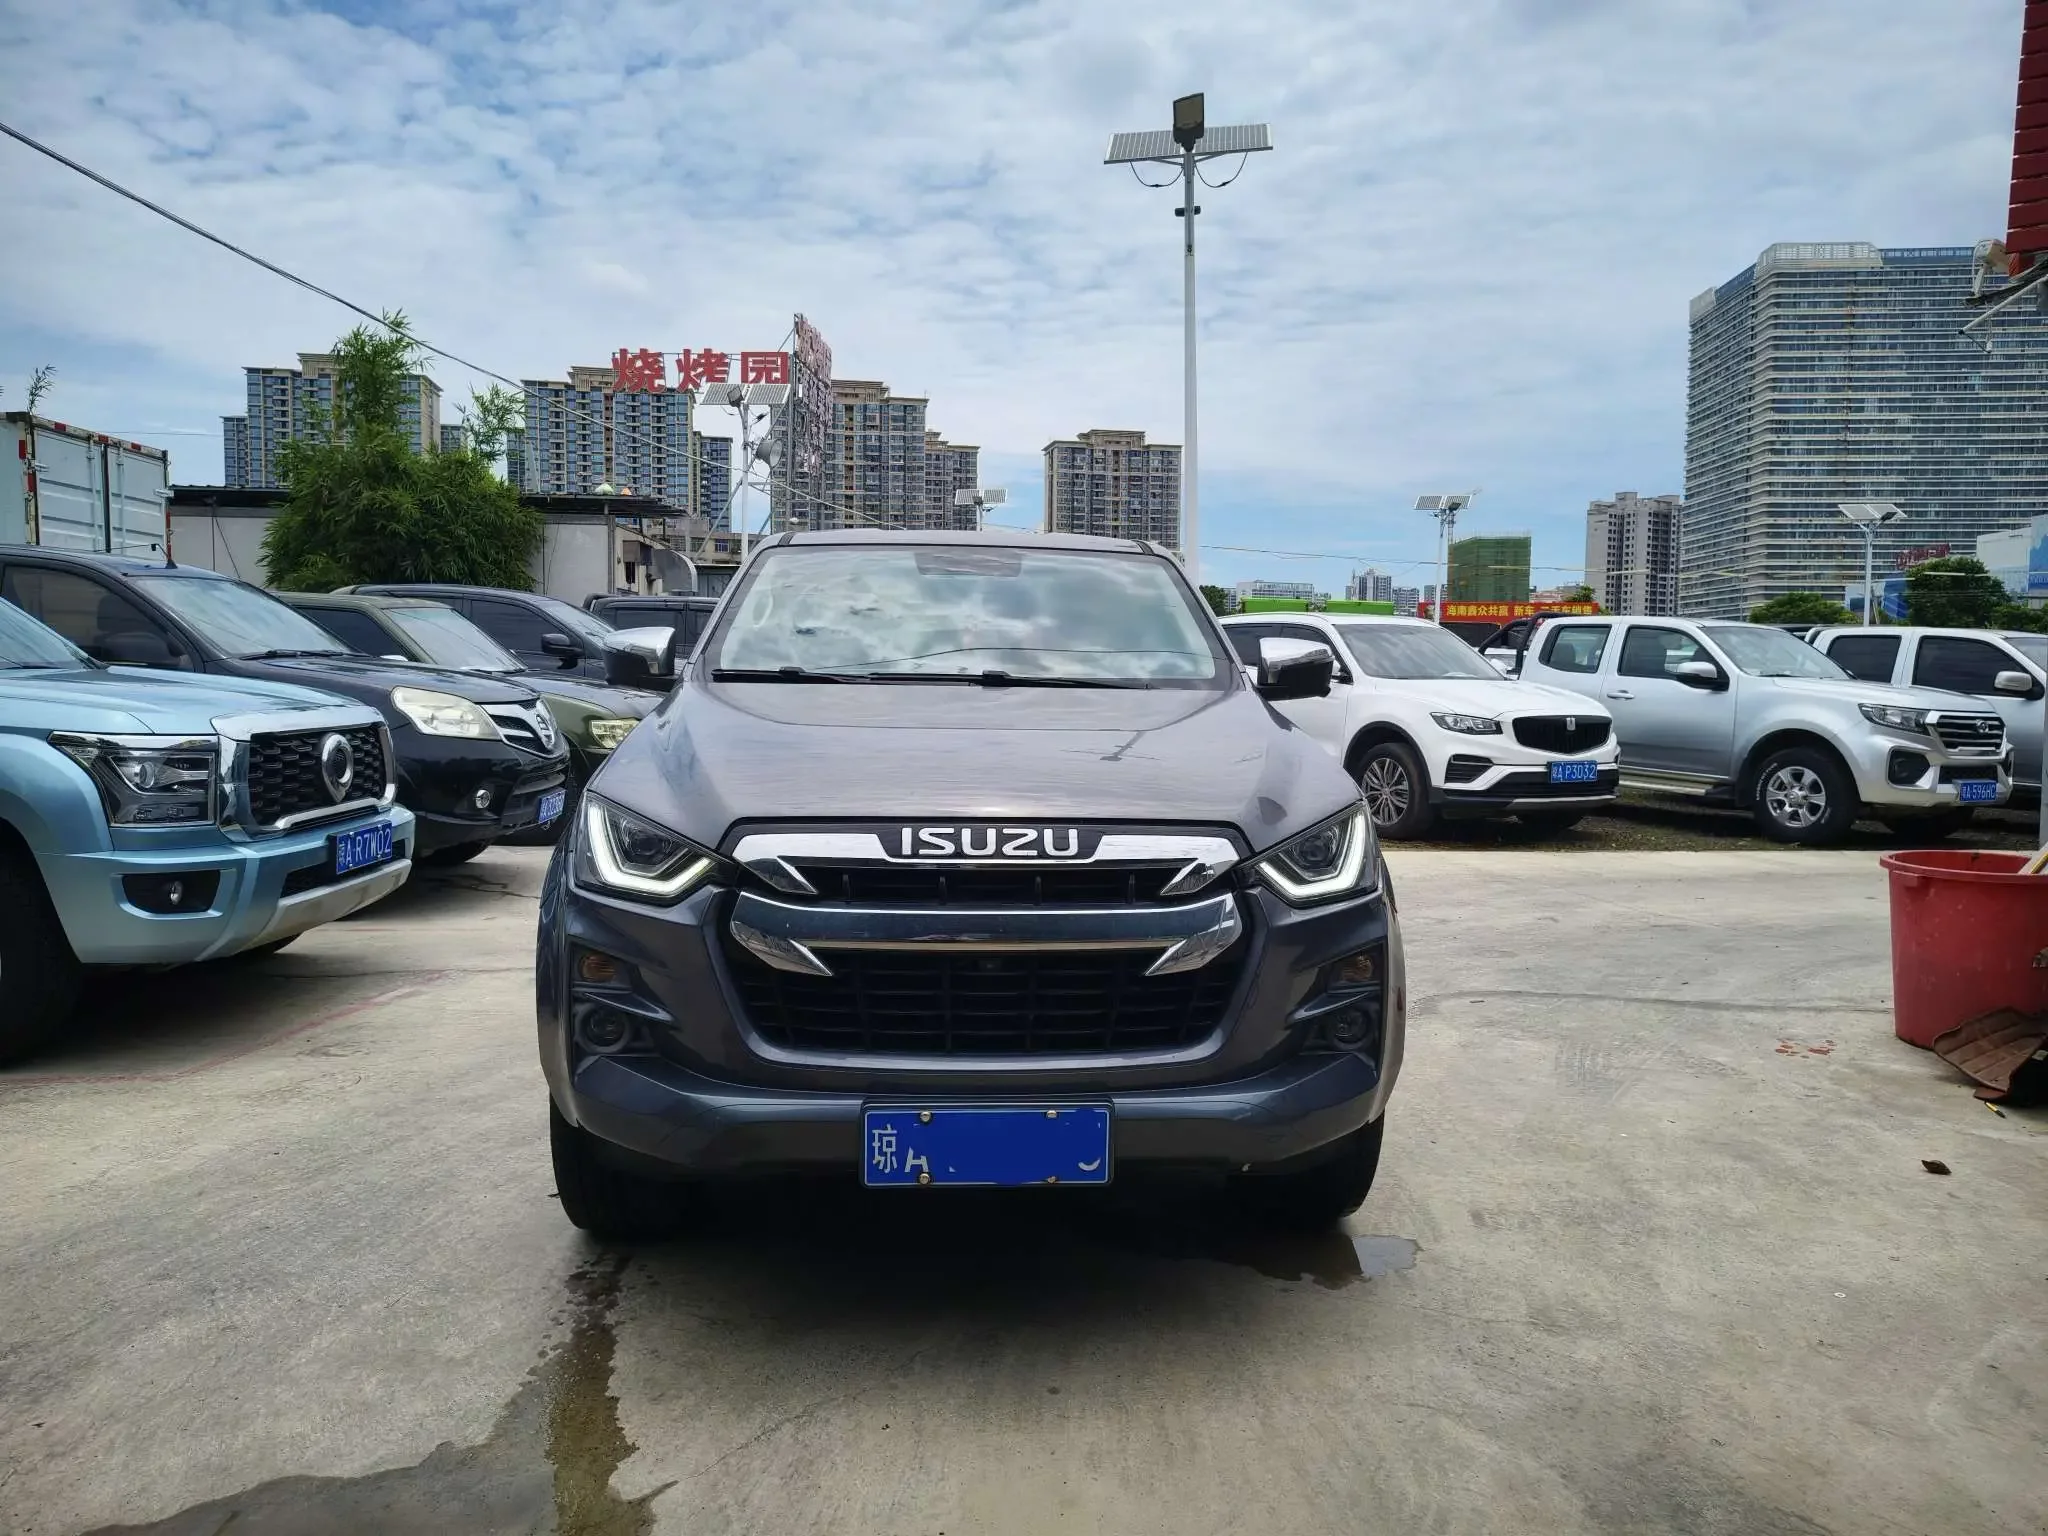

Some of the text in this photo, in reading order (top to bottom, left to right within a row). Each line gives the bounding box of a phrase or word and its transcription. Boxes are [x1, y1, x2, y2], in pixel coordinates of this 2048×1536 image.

[611, 347, 790, 394] 烧烤园
[901, 827, 1078, 857] ISUZU
